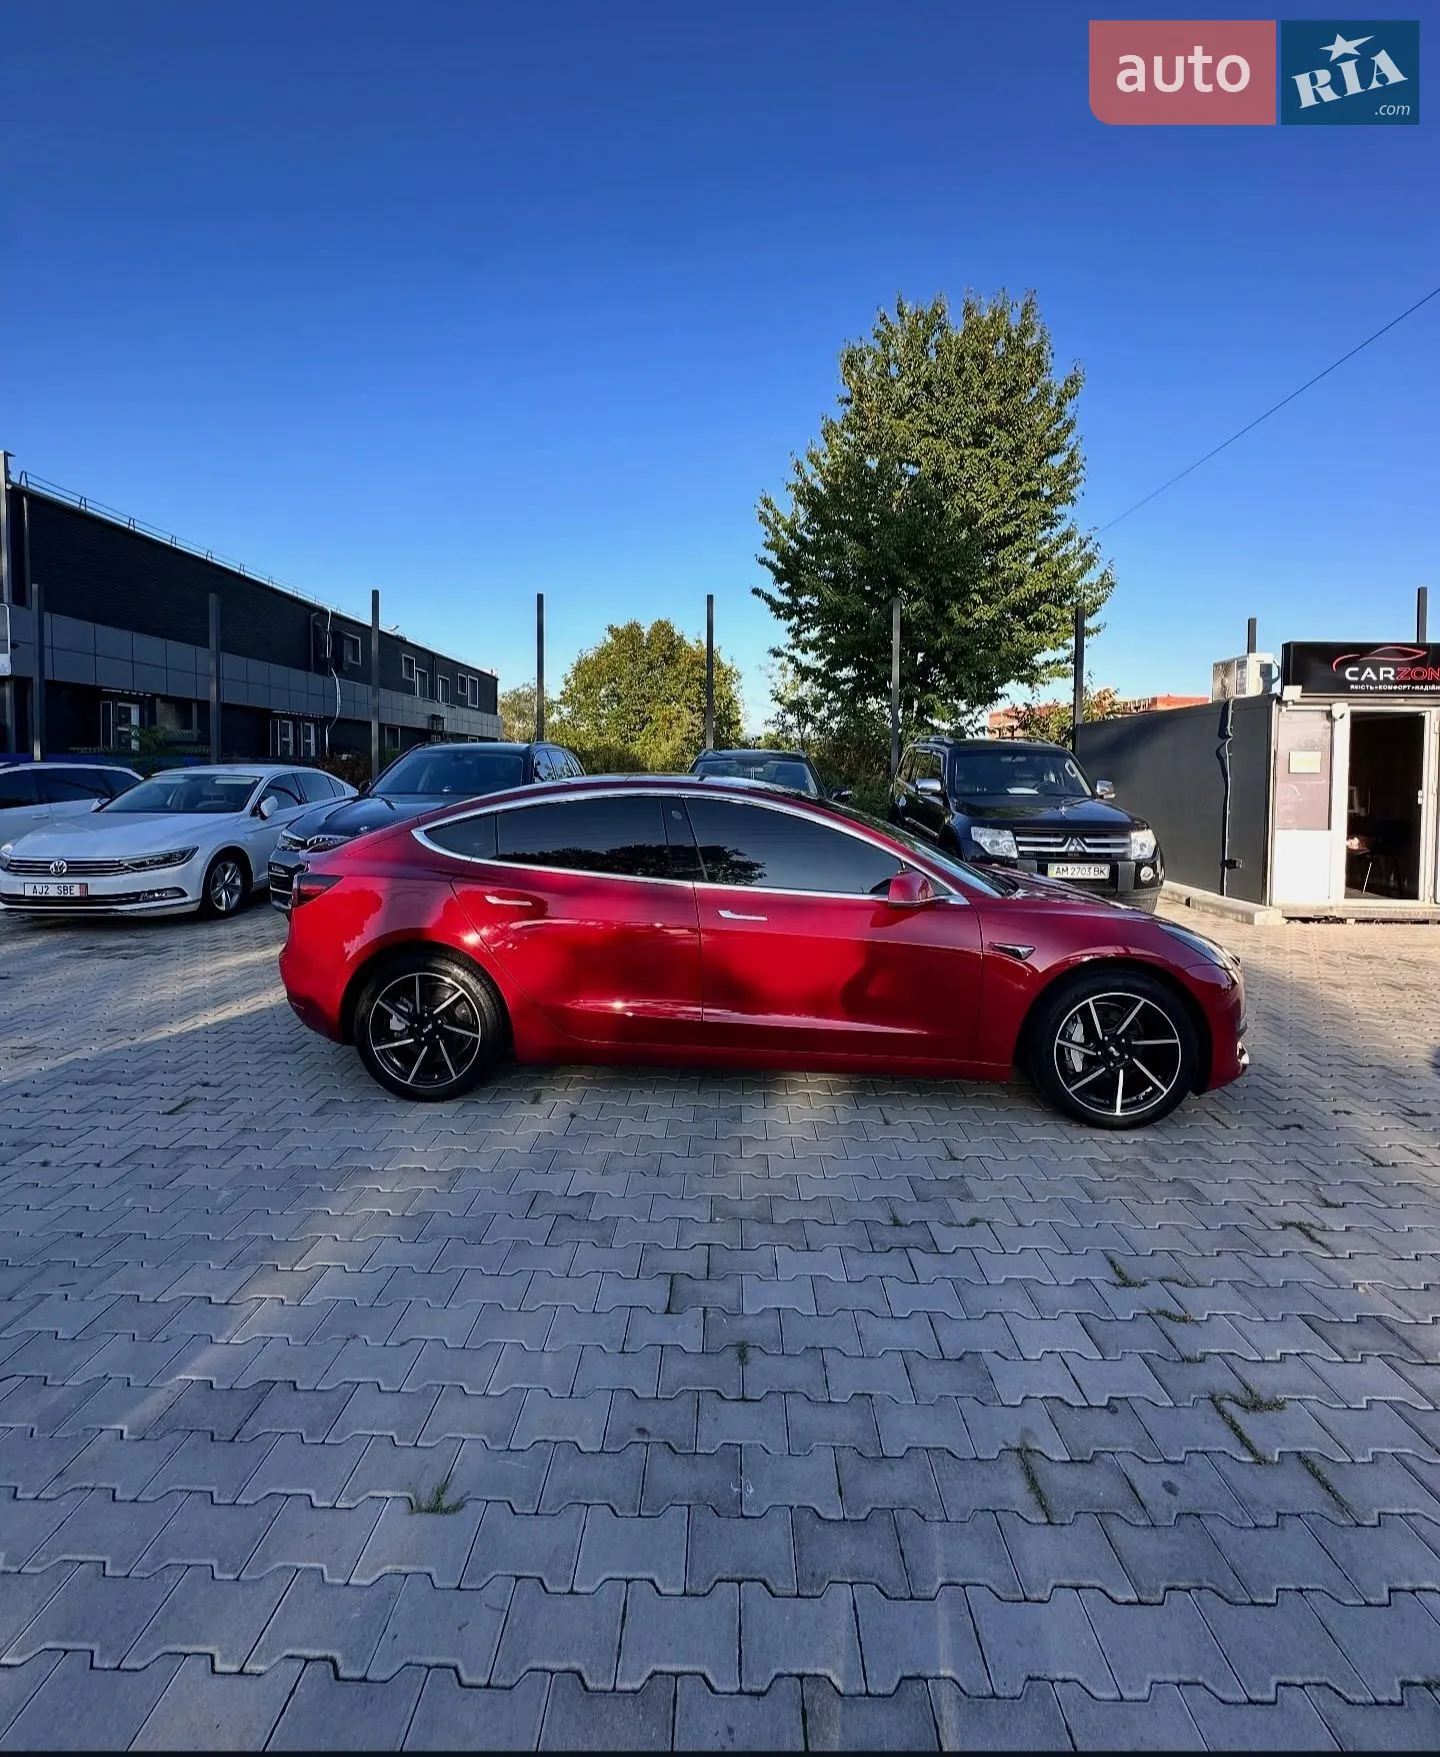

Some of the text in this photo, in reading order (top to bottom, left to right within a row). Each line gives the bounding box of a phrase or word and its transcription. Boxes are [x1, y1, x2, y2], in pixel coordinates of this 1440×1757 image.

[1344, 666, 1440, 681] CARZON
[32, 885, 50, 895] AJ2
[56, 885, 75, 895] SBE
